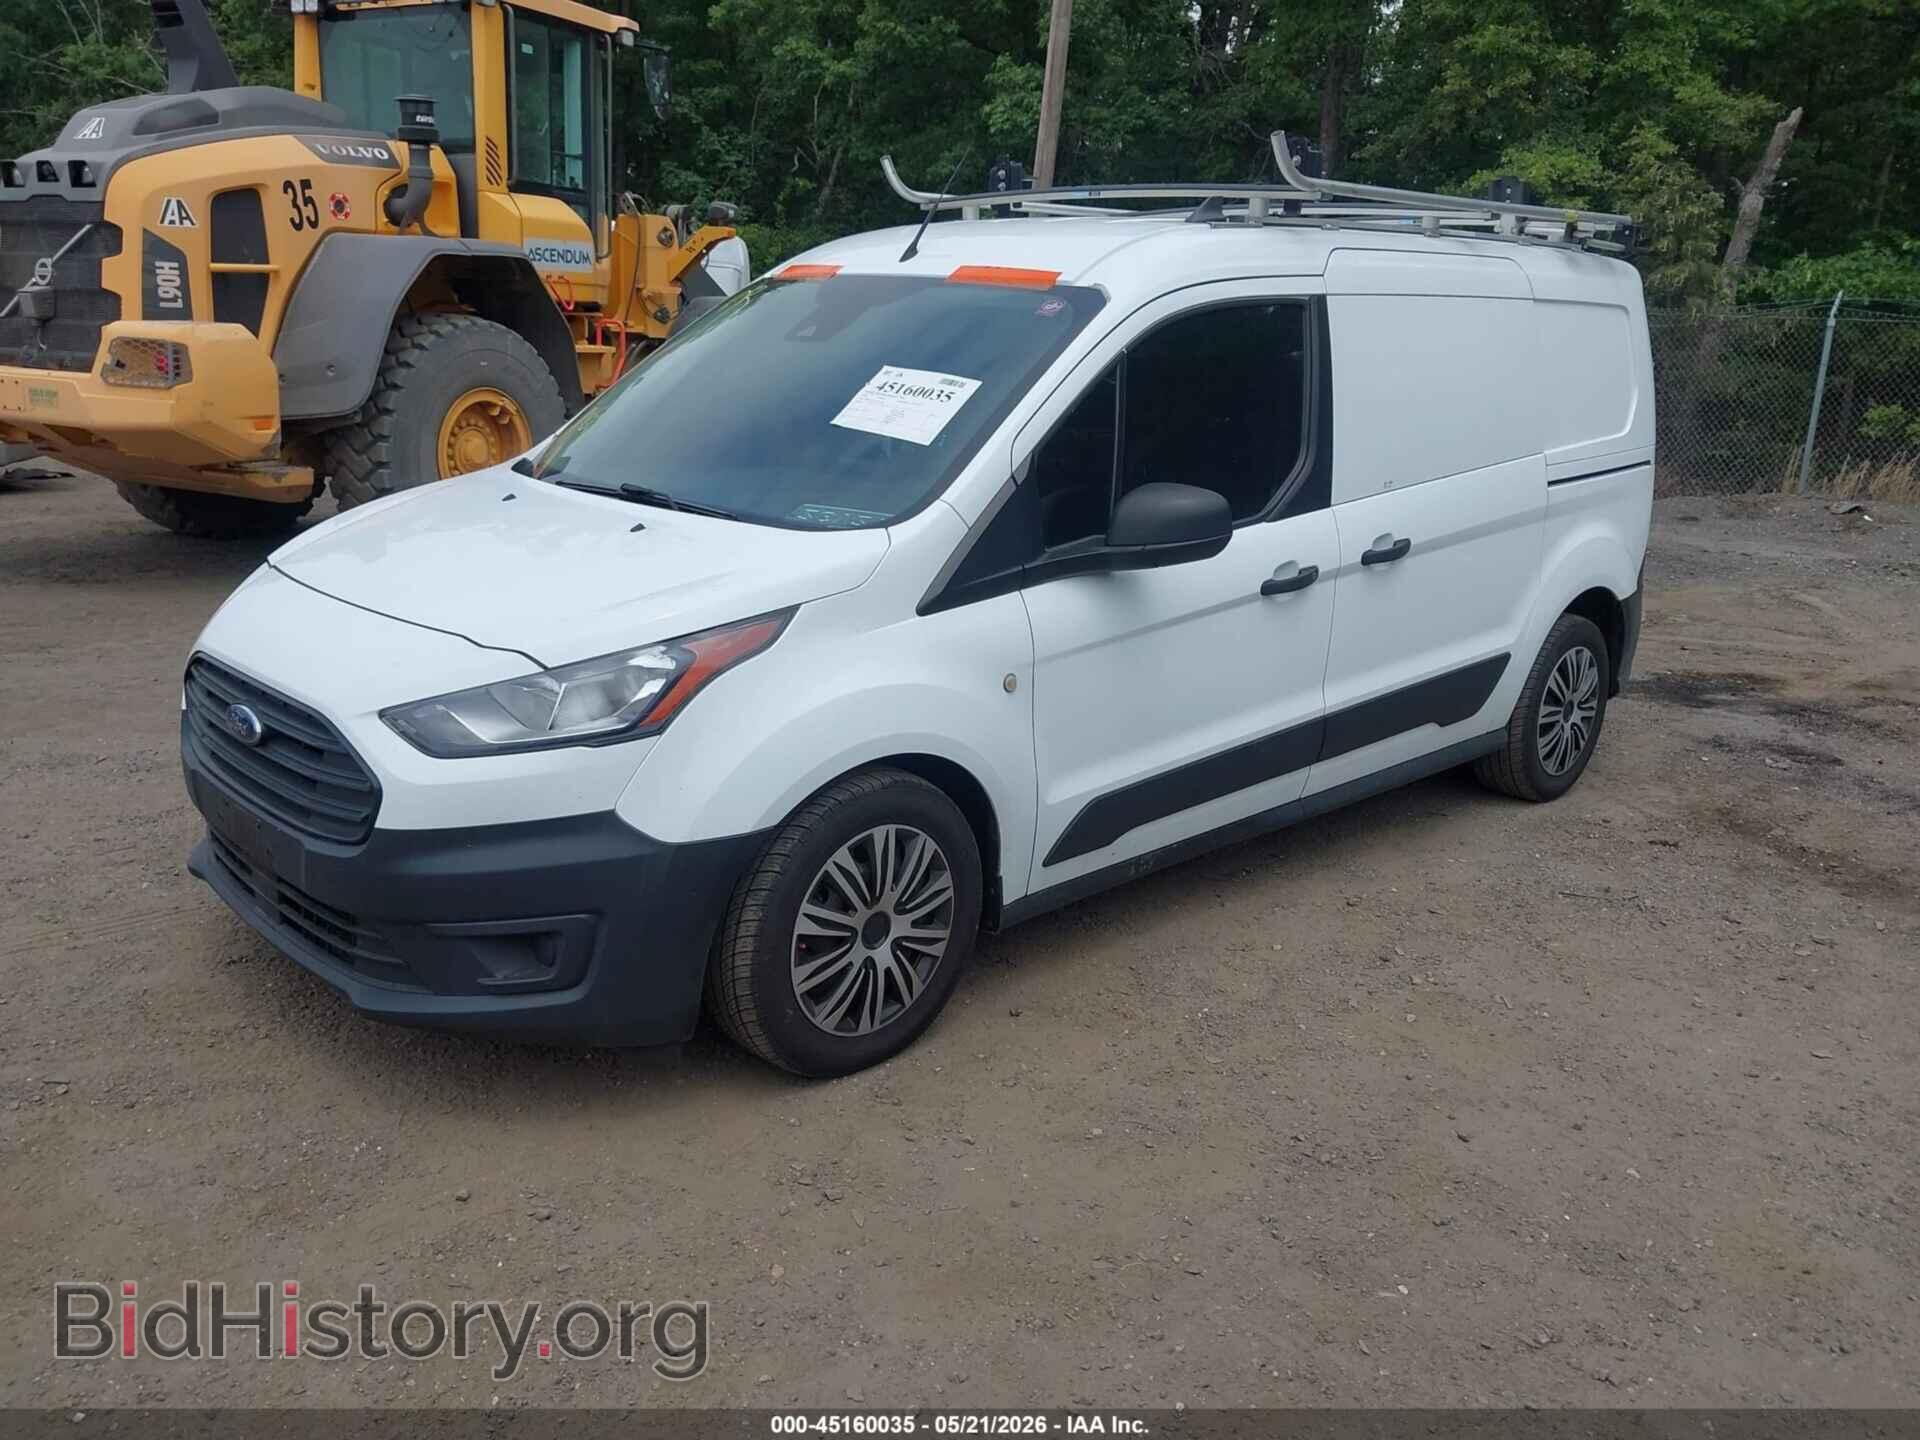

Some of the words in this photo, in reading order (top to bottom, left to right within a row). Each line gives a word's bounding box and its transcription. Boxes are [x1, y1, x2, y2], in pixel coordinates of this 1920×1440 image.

[314, 143, 390, 160] VOLVO
[283, 178, 319, 231] 35
[528, 247, 592, 265] ASCENDUM
[154, 260, 184, 308] L90H
[876, 380, 956, 403] 45160035
